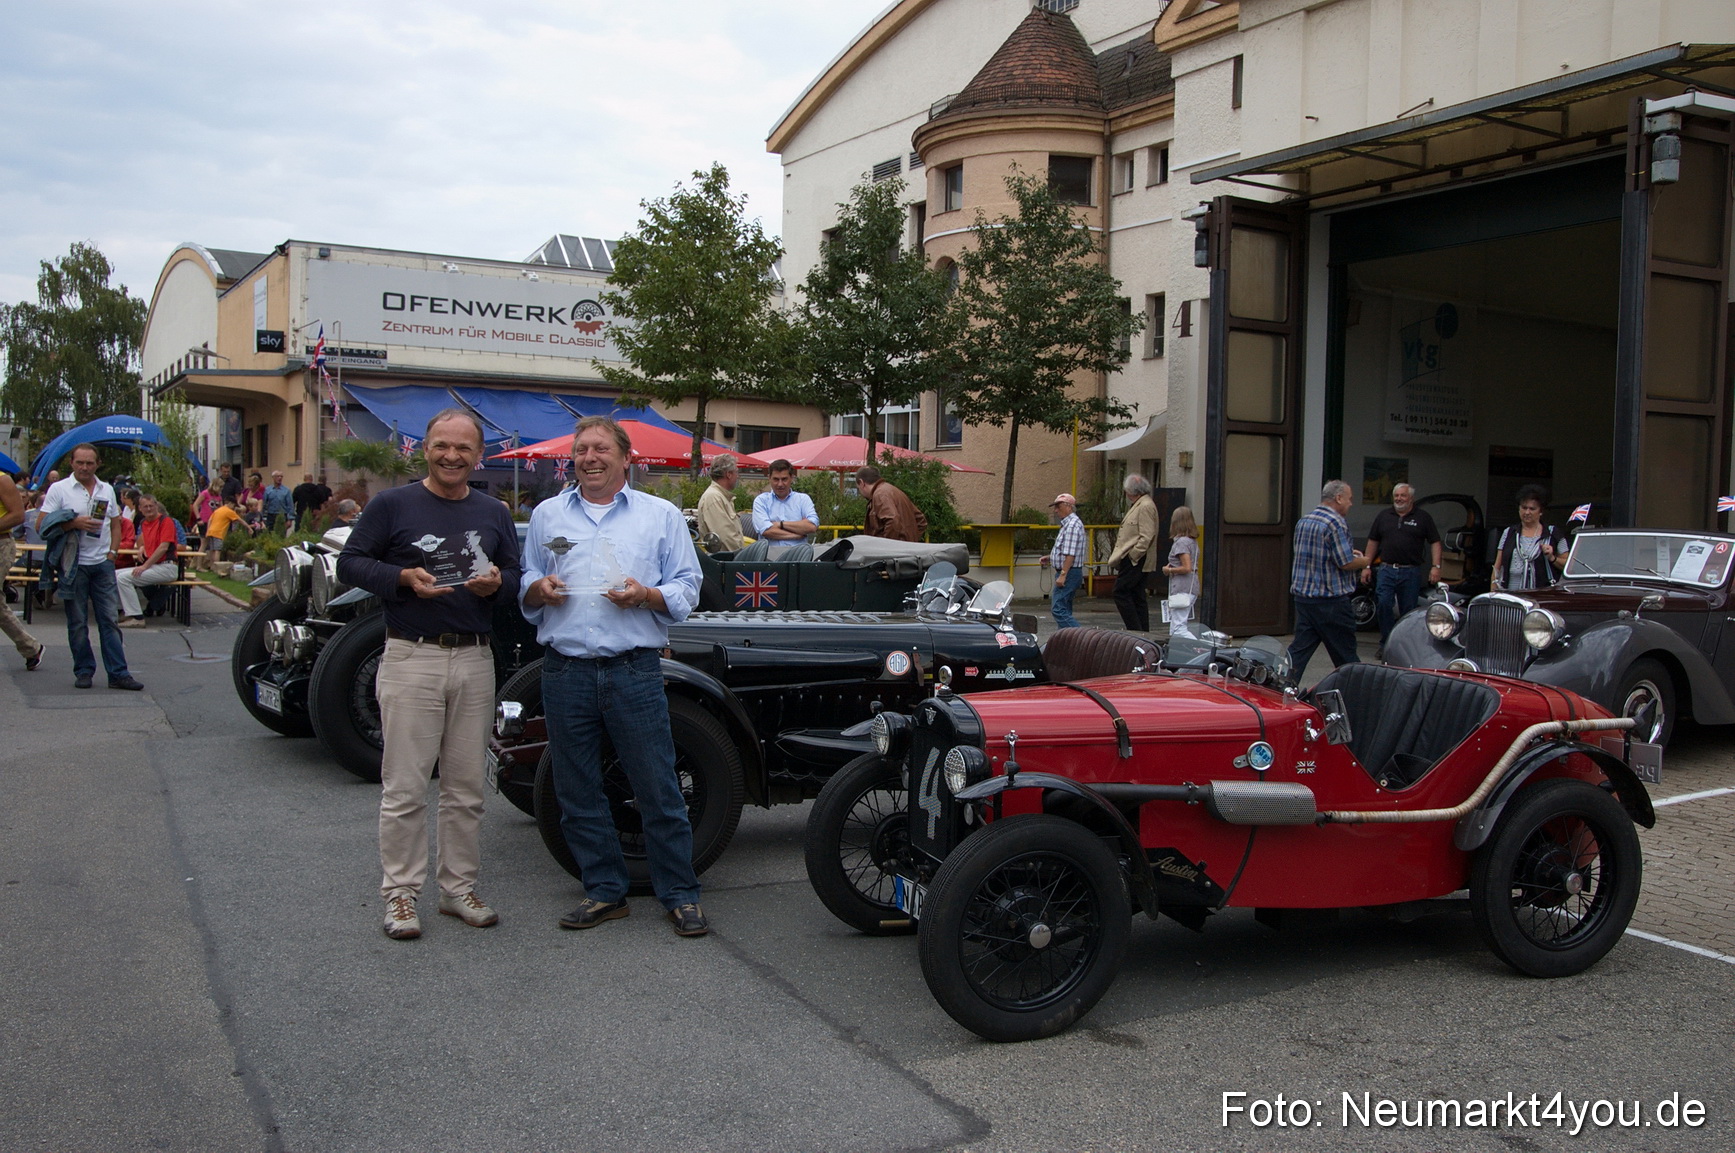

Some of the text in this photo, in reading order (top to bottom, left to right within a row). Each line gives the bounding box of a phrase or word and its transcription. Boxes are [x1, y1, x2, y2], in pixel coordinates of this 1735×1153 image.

[383, 292, 568, 326] OFENWERK
[1172, 300, 1193, 338] 4
[260, 334, 281, 348] sky
[382, 320, 606, 348] ZENTRUM FÜR MOBILE CLASSIC
[1403, 338, 1439, 369] vtg
[890, 653, 908, 673] AGIP
[918, 747, 941, 840] 4
[1150, 856, 1199, 881] Austin
